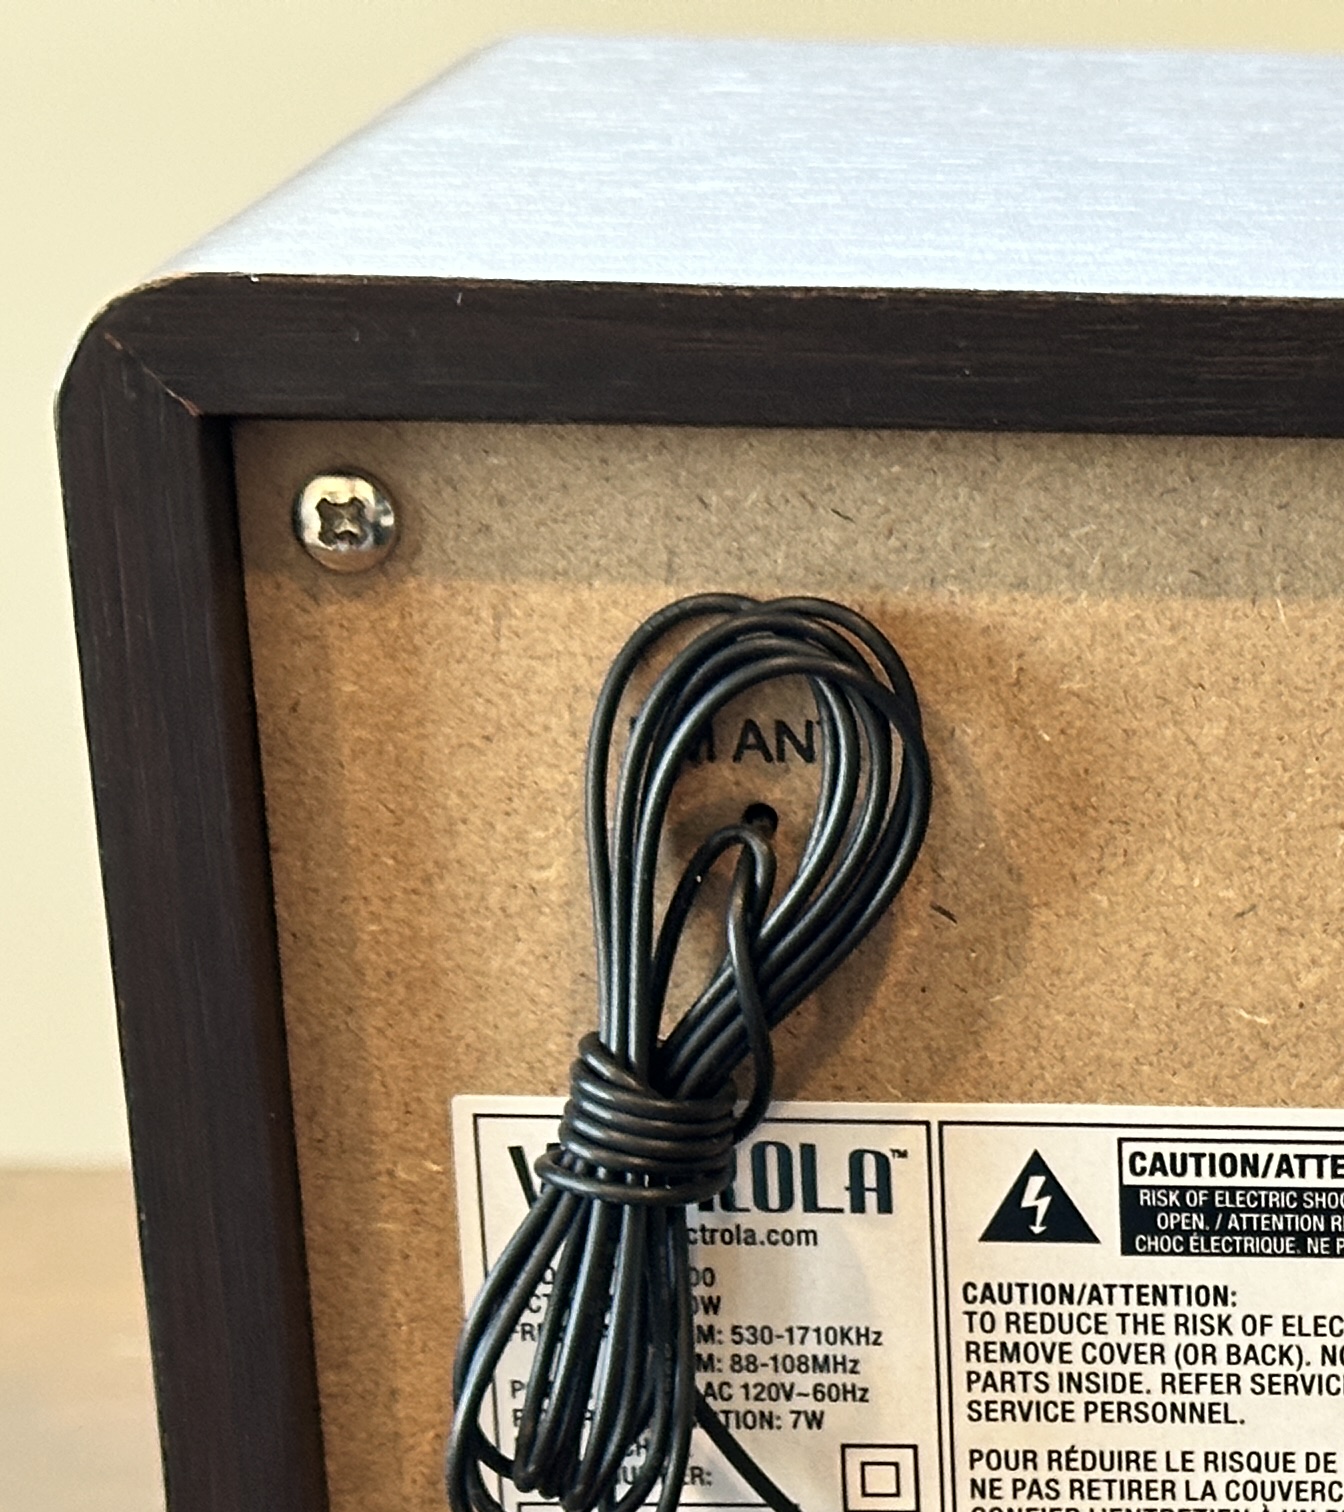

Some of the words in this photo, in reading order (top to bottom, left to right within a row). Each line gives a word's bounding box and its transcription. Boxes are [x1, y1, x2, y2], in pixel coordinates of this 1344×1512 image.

[733, 718, 821, 763] AN
[1140, 1189, 1181, 1207] RISK
[1186, 1190, 1209, 1207] OF
[1215, 1190, 1297, 1209] ELECTRIC
[1157, 1212, 1210, 1230] OPEN.
[1227, 1213, 1325, 1232] ATTENTION
[1135, 1234, 1184, 1253] CHOC
[1189, 1232, 1300, 1254] ÉLECTRIQUE.
[1307, 1237, 1330, 1254] NE
[962, 1281, 1237, 1307] CAUTION/ATTENTION:
[962, 1310, 996, 1334] TO
[1005, 1311, 1108, 1335] REDUCE
[1115, 1312, 1165, 1336] THE
[1174, 1313, 1233, 1336] RISK
[1241, 1314, 1273, 1337] OF
[730, 1325, 884, 1346] 530-1710KHz
[729, 1353, 861, 1375] 88-108MHz
[703, 1381, 734, 1402] AC
[740, 1382, 871, 1403] 120V~60Hz
[790, 1409, 825, 1430] 7W
[969, 1449, 1038, 1471] POUR
[1047, 1444, 1157, 1472] RÉDUIRE
[1165, 1450, 1195, 1472] LE
[1204, 1451, 1296, 1474] RISQUE
[1305, 1452, 1337, 1474] DE
